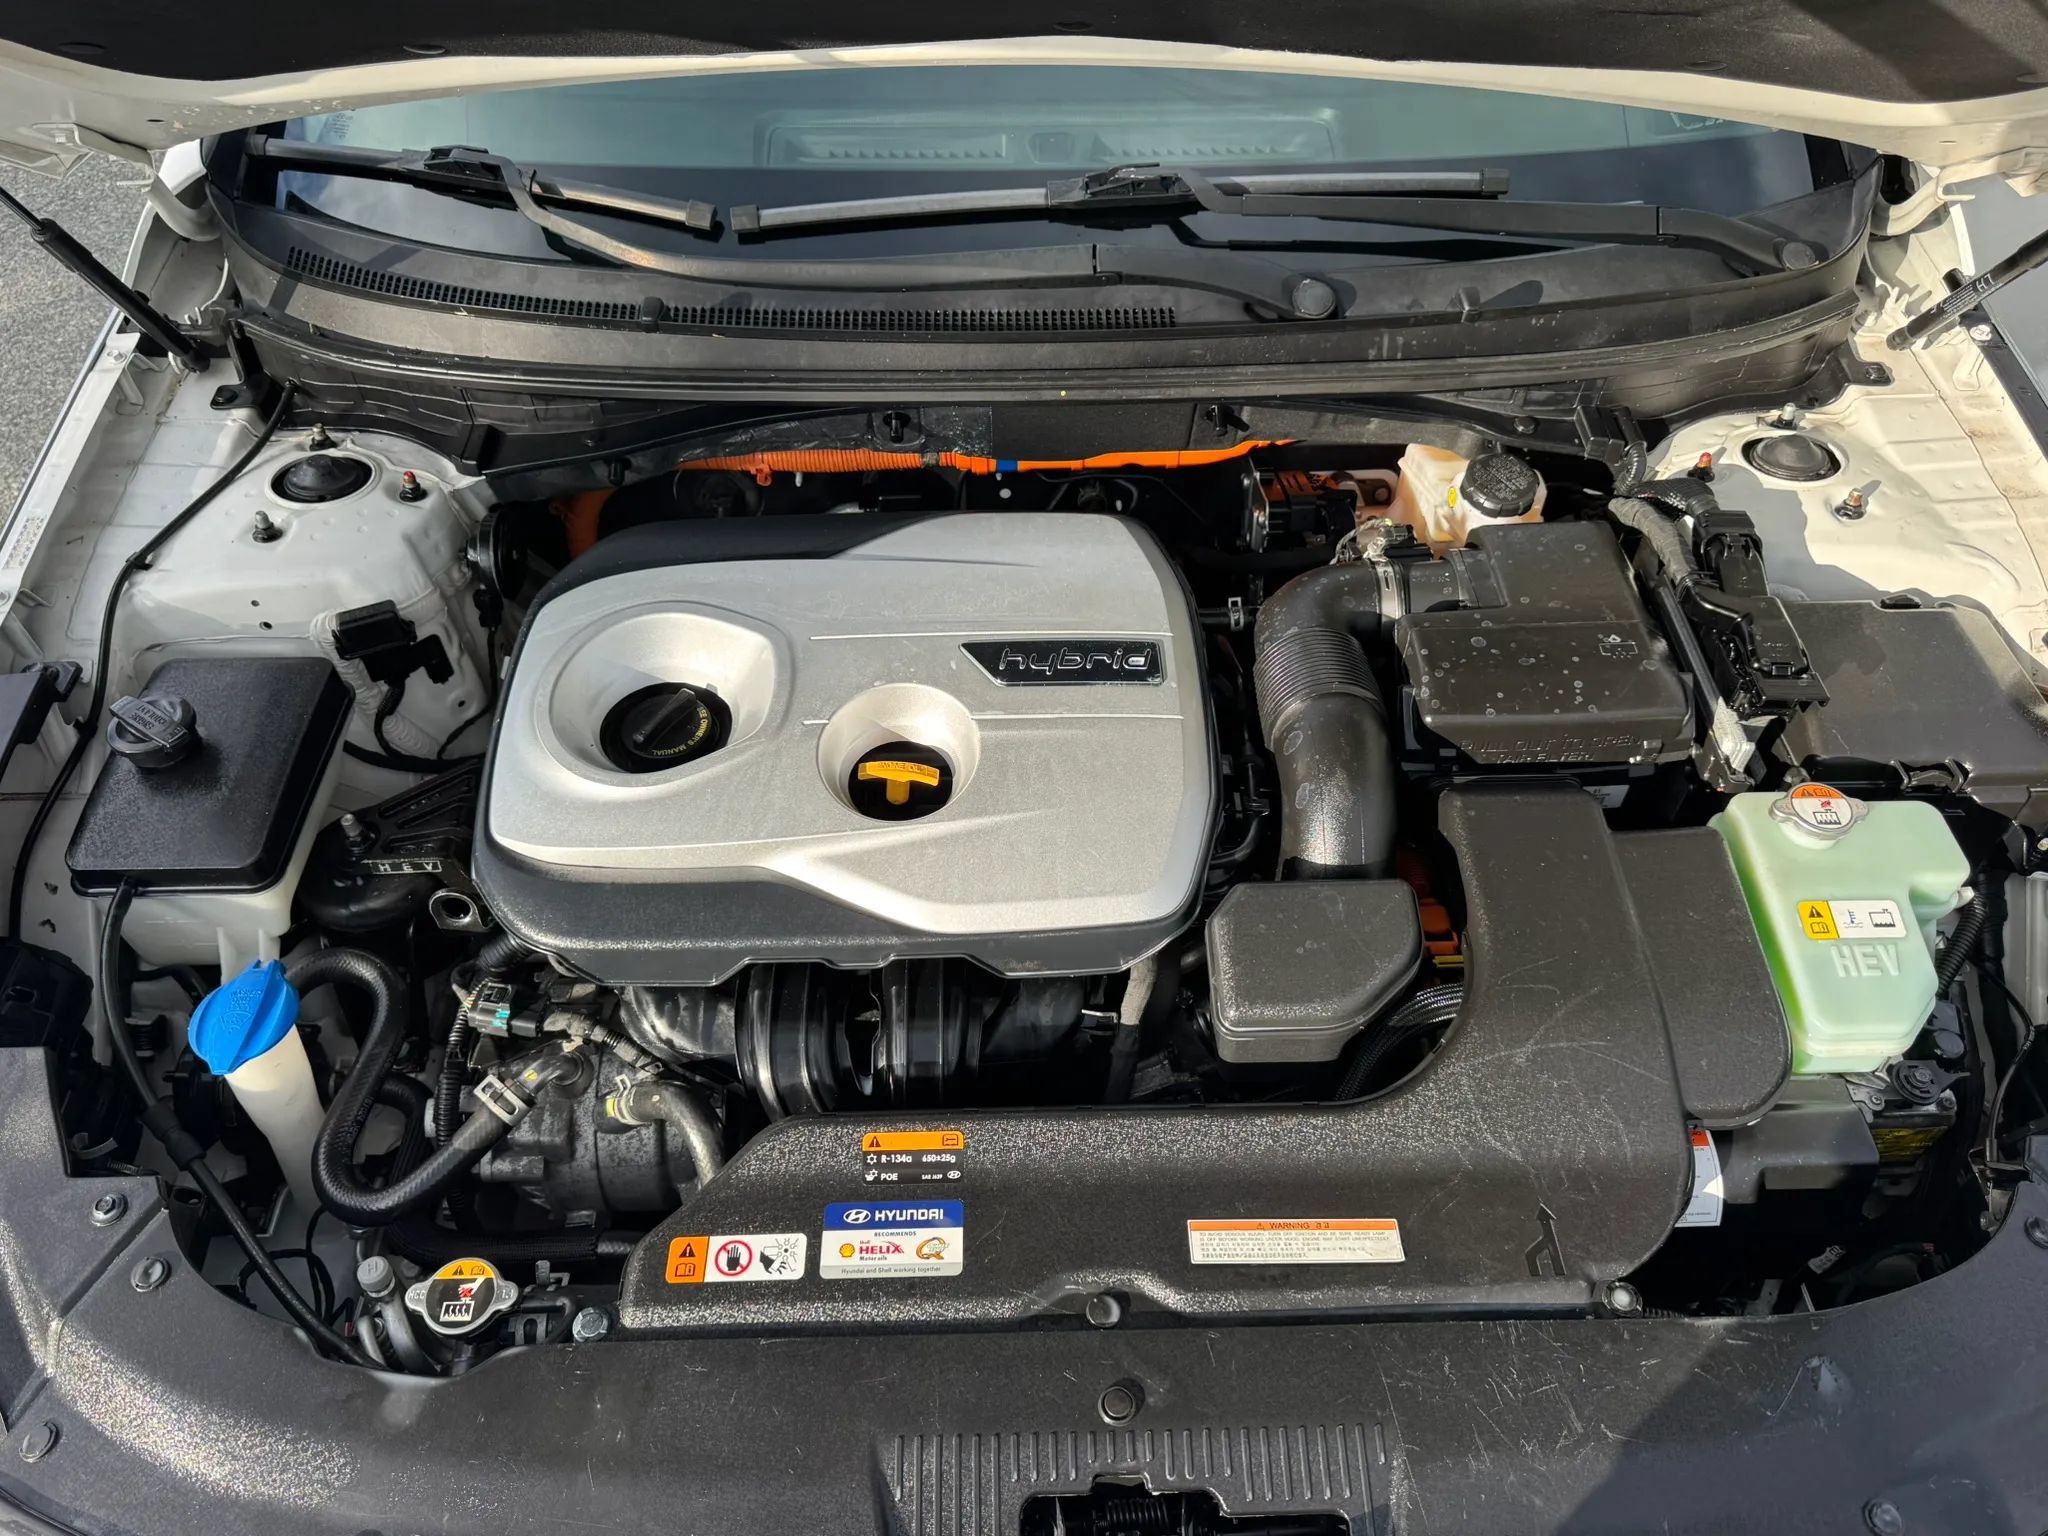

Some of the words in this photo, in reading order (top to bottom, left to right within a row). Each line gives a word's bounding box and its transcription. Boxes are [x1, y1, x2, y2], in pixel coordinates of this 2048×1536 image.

[998, 647, 1152, 675] hybrid
[652, 745, 687, 756] MANUAL
[378, 862, 433, 872] HEV
[1830, 944, 1900, 977] HEV
[881, 1154, 912, 1164] R-134a
[921, 1154, 956, 1164] 650±25g
[881, 1173, 899, 1181] POE
[875, 1208, 944, 1222] HYUNDAI
[1269, 1222, 1311, 1230] WARNING
[859, 1243, 905, 1255] HELIX
[841, 1267, 865, 1275] Hyundai
[893, 1266, 916, 1274] working
[917, 1265, 941, 1273] together
[408, 1290, 425, 1300] HCC
